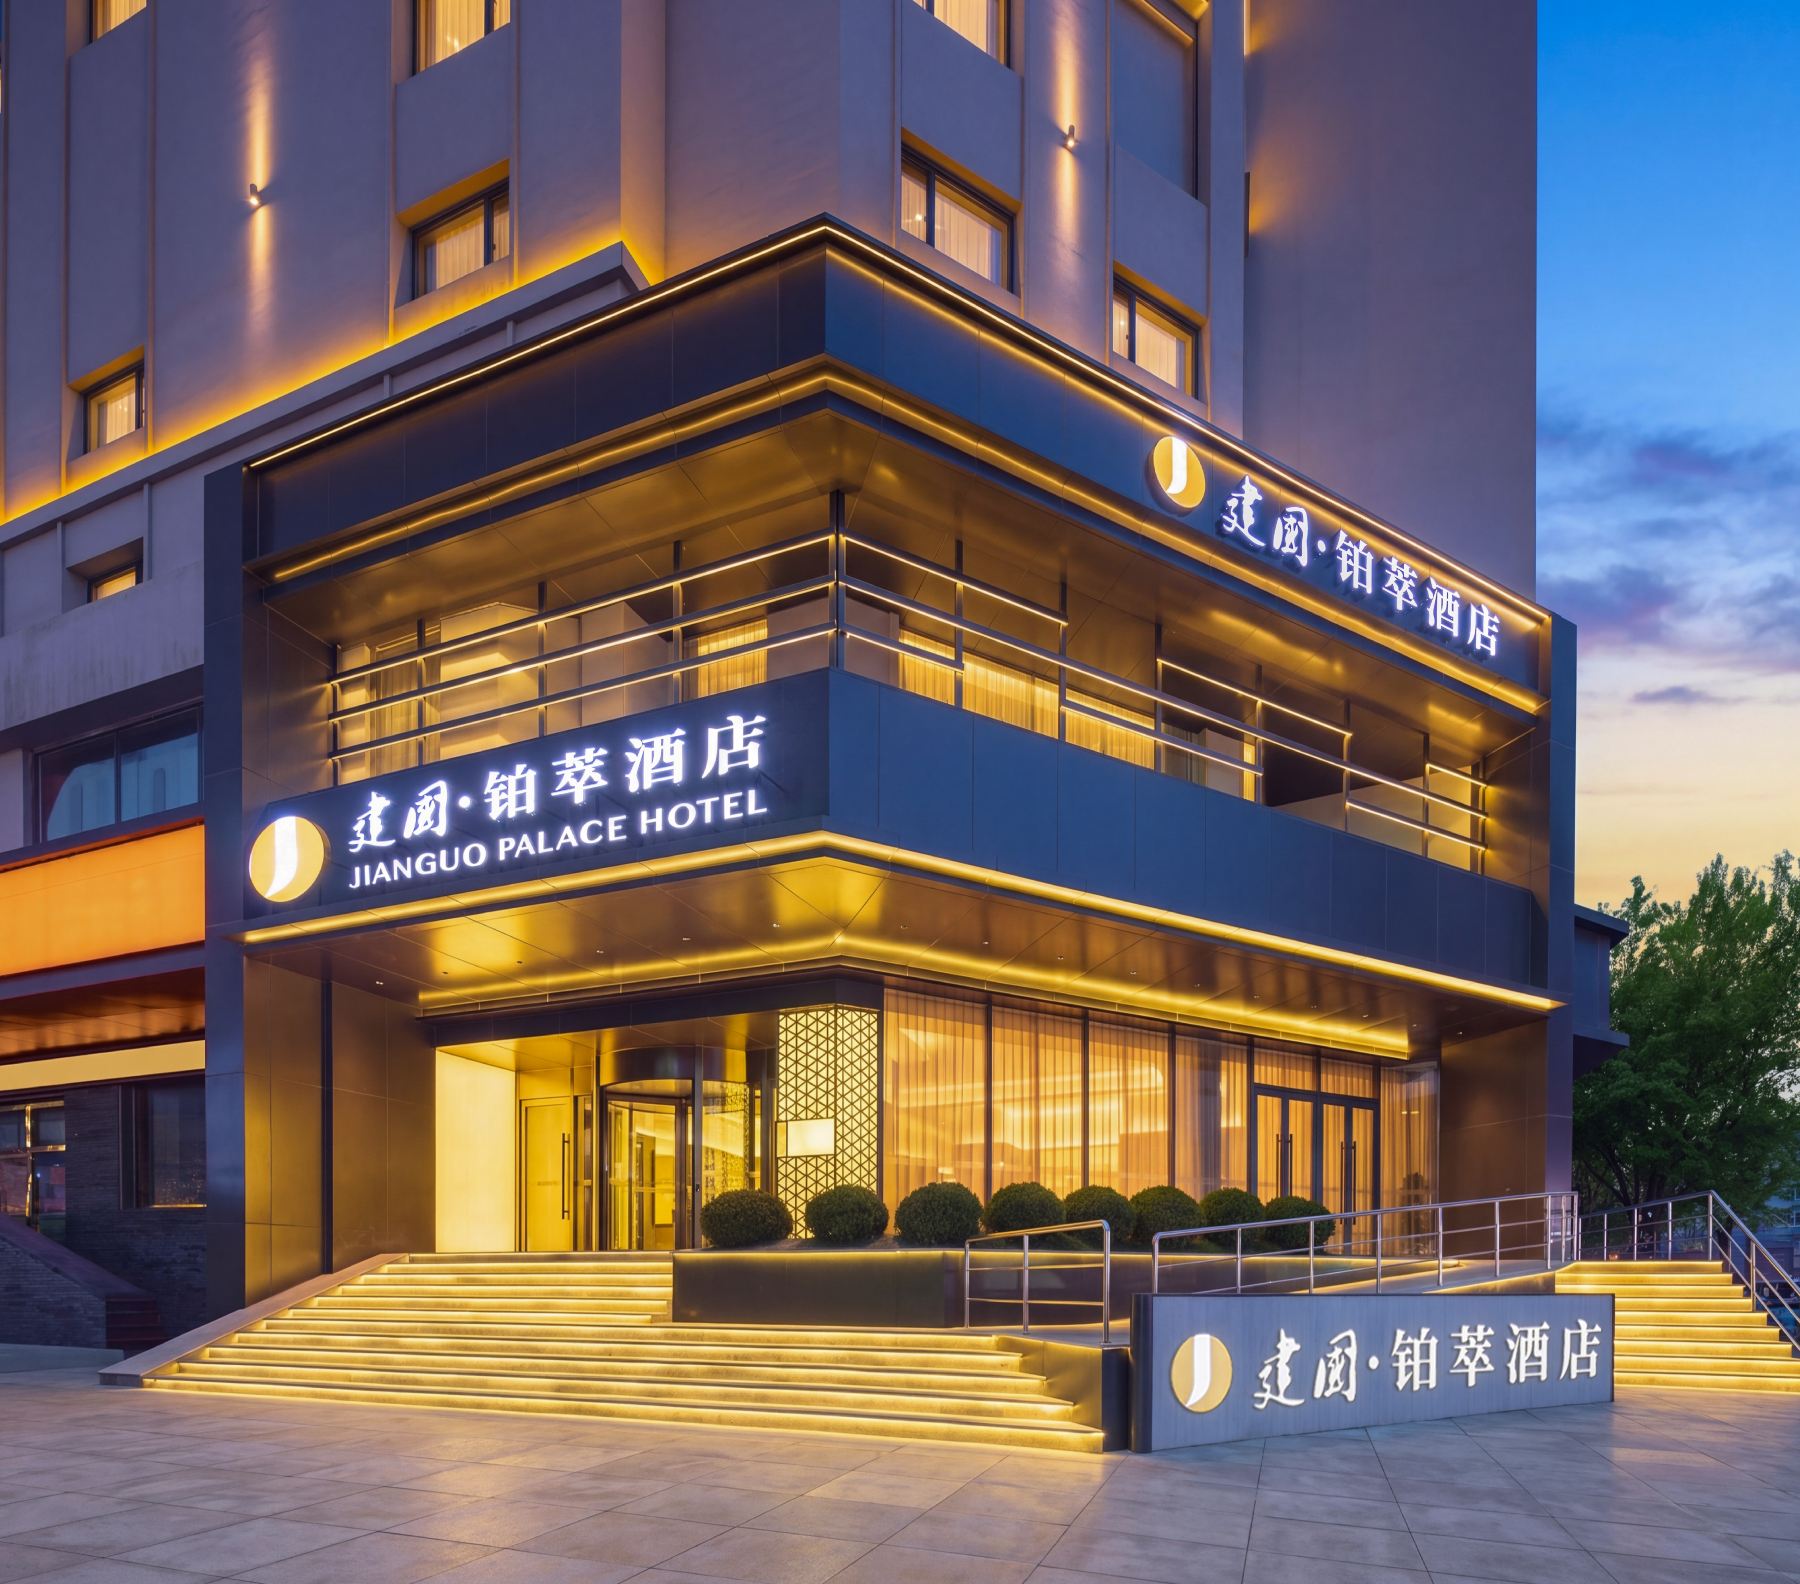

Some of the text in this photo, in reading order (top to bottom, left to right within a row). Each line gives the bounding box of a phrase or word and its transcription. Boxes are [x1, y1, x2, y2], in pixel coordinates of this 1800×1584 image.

[349, 788, 768, 889] JIANGUO PALACE HOTEL
